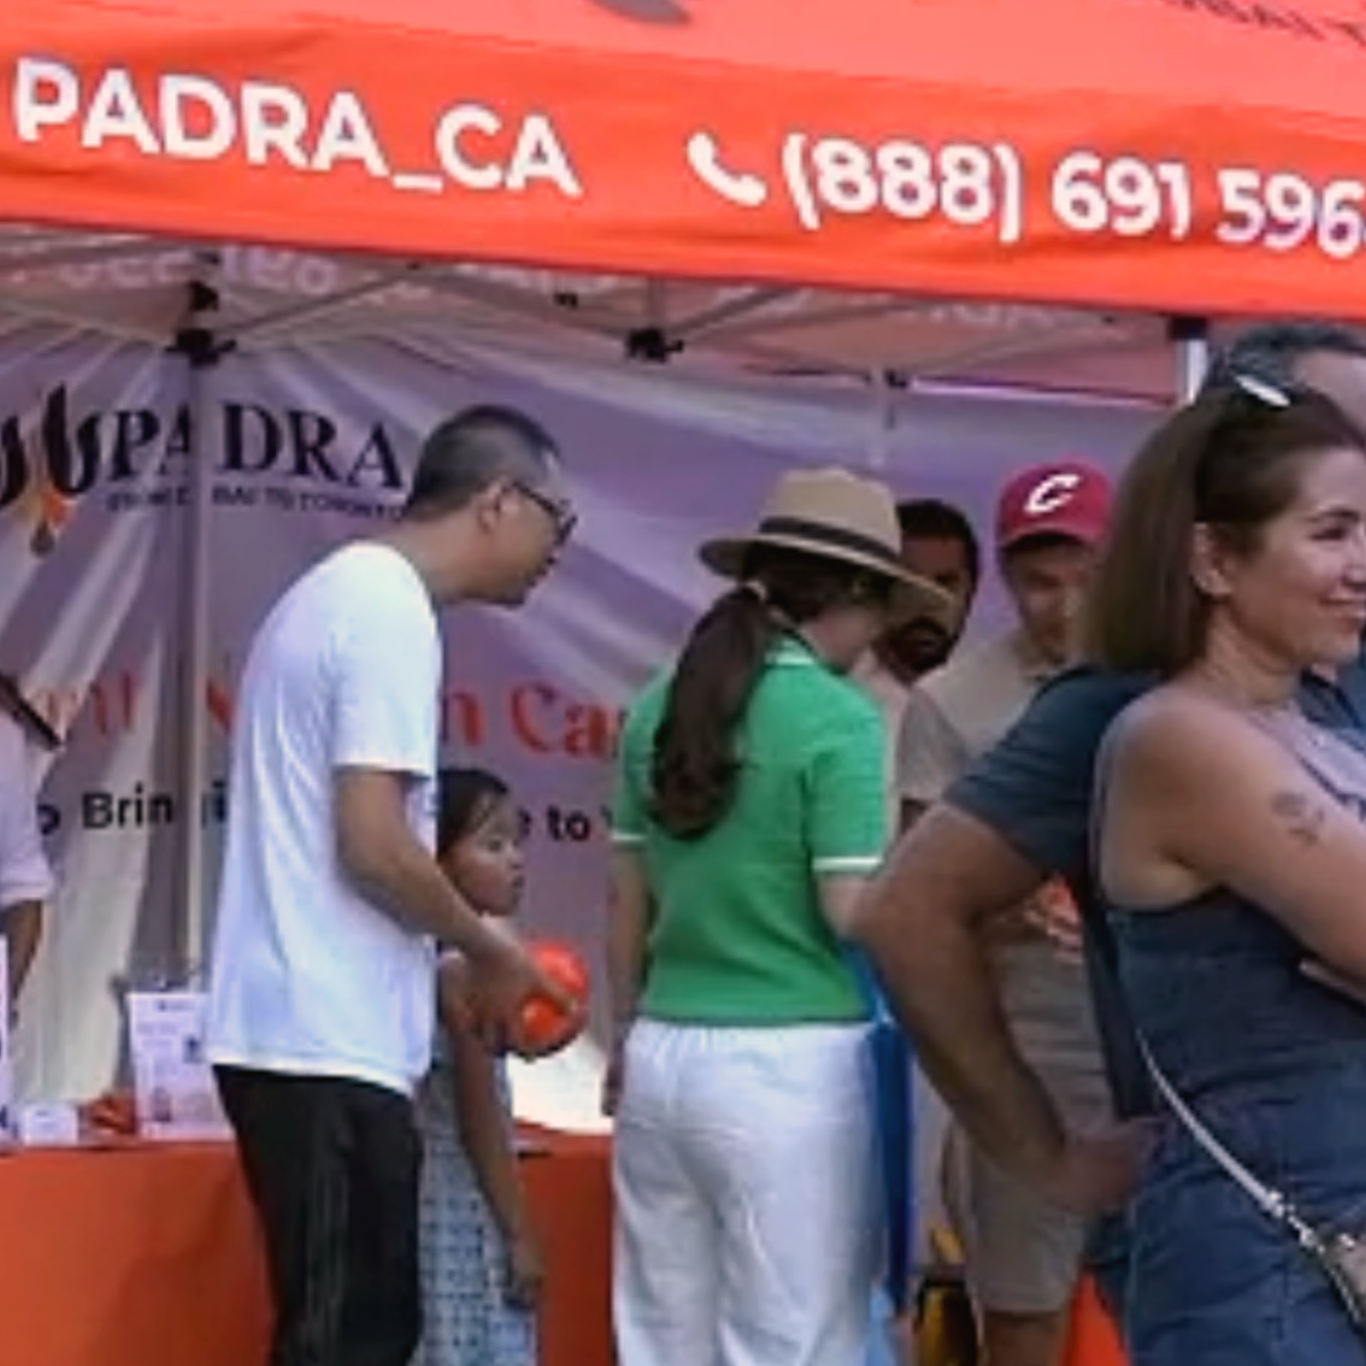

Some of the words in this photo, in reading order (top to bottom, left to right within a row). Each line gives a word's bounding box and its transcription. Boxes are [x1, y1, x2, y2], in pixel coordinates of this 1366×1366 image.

[13, 55, 583, 199] PADRA_CA
[781, 132, 1022, 244] (888)
[1051, 149, 1191, 240] 691
[1023, 472, 1082, 515] C
[546, 803, 592, 842] to
